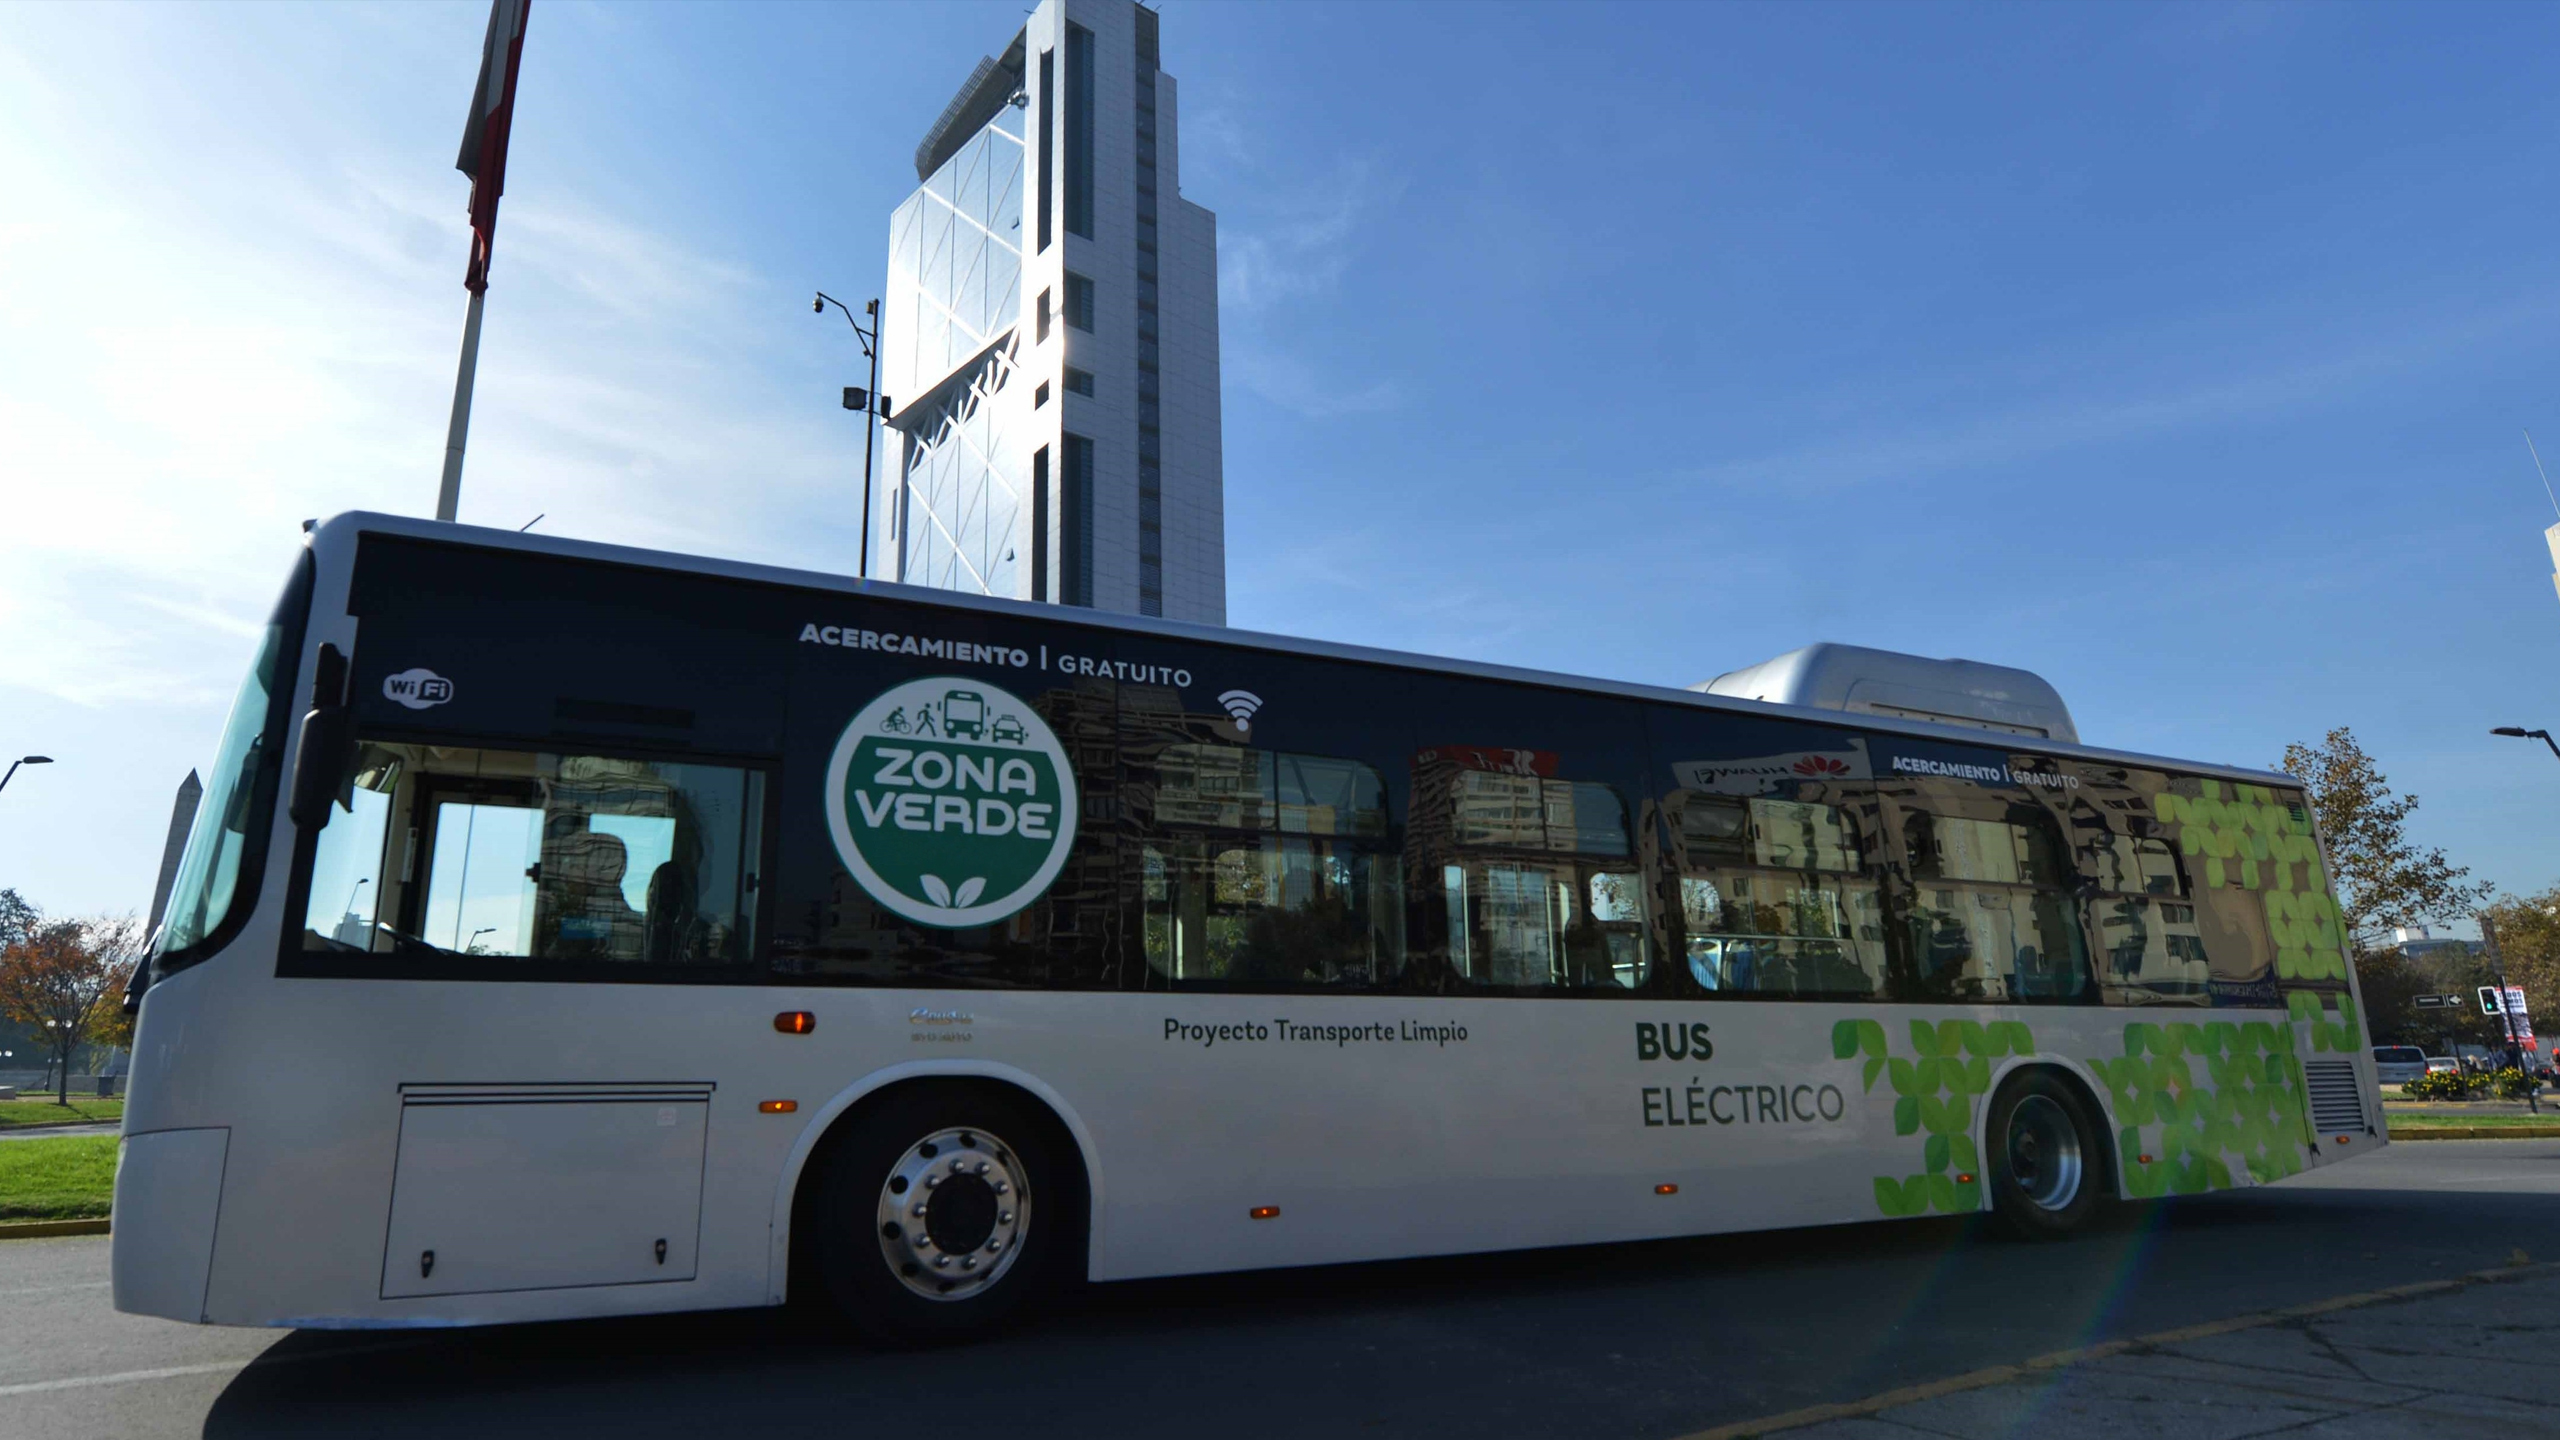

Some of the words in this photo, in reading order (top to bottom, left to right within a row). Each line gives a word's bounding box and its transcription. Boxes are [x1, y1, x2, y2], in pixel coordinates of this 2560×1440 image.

[798, 622, 1030, 668] ACERCAMIENTO
[1058, 654, 1193, 688] GRATUITO
[873, 746, 1037, 796] ZONA
[1891, 755, 2001, 782] ACERCAMIENTO
[2012, 770, 2080, 790] GRATUITO
[854, 789, 1053, 840] VERDE
[1163, 1018, 1269, 1047] Proyecto
[1274, 1018, 1395, 1047] Transporte
[1401, 1019, 1469, 1047] Limpio
[1635, 1022, 1714, 1061] BUS
[1641, 1076, 1844, 1127] ELÉCTRICO
